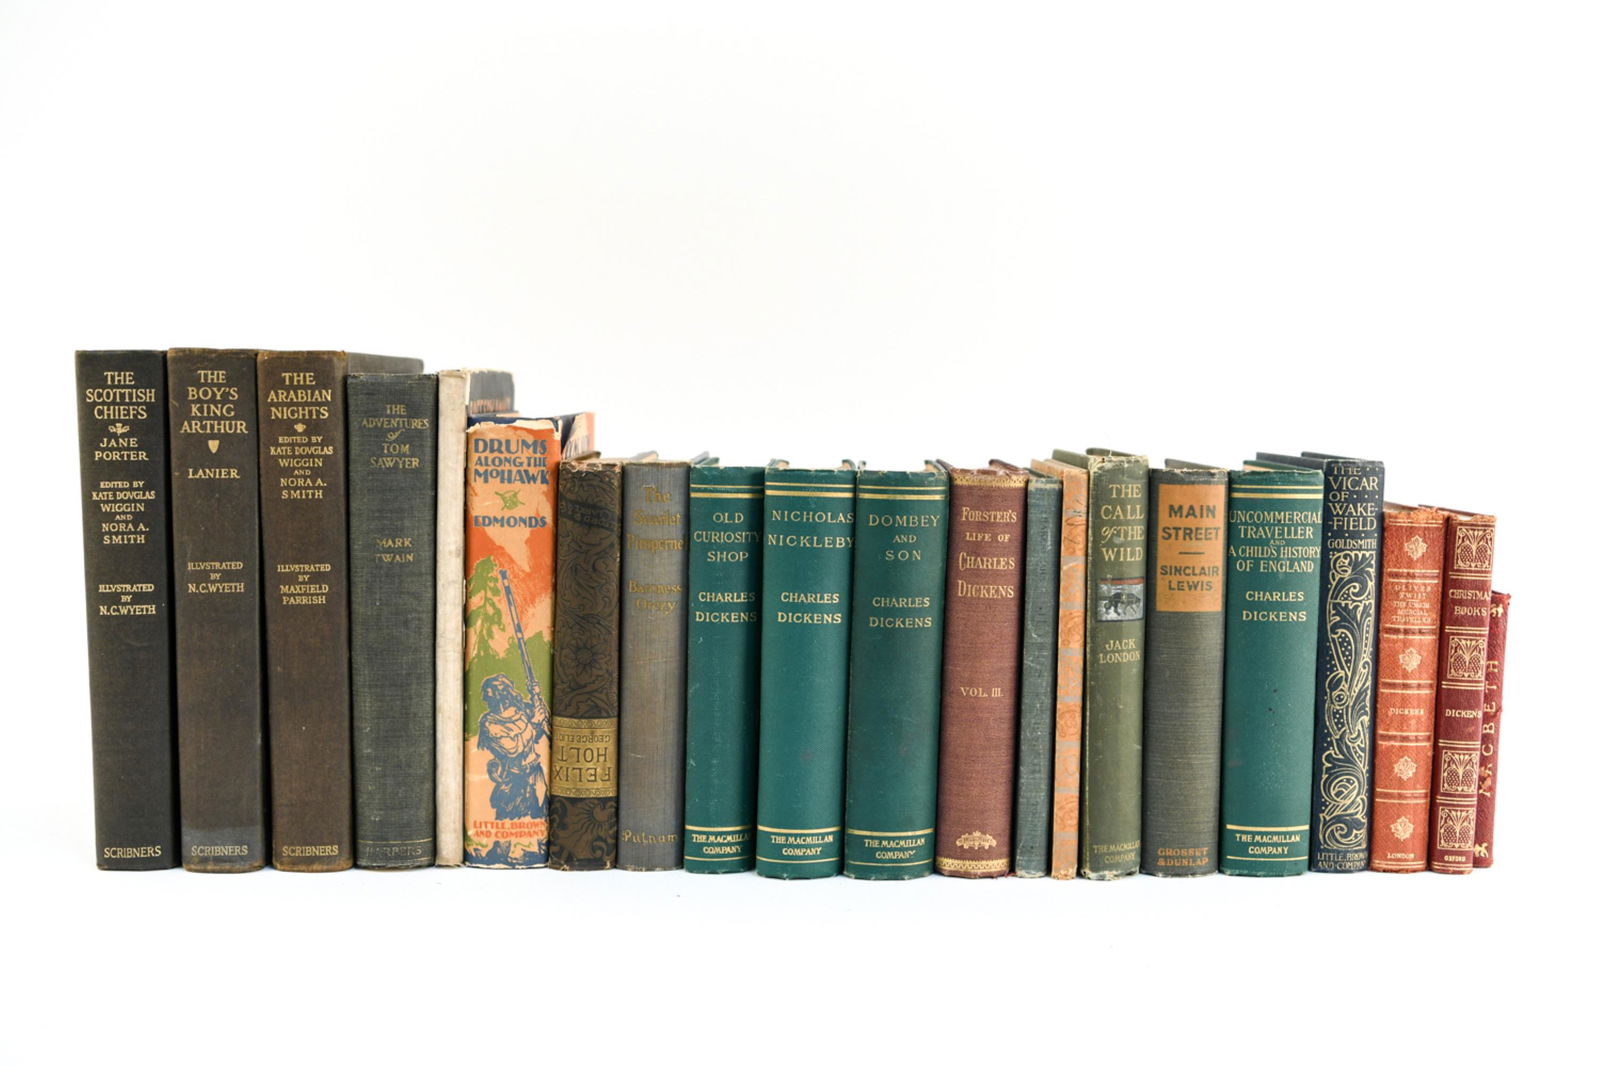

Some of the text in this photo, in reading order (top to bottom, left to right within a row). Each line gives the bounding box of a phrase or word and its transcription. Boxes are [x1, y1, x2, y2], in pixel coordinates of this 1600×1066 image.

[104, 371, 134, 385] THE
[198, 370, 227, 383] THE
[281, 372, 316, 385] THE
[86, 388, 156, 403] SCOTTISH
[187, 386, 239, 401] BOY'S
[267, 389, 332, 403] ARABIAN
[94, 404, 147, 420] CHIEFS
[191, 404, 235, 417] KING
[270, 406, 329, 420] NIGHTS
[386, 404, 407, 415] THE
[180, 420, 248, 434] ARTHUR
[361, 418, 430, 430] ADVENTURES
[278, 436, 323, 444] EDITED BY
[385, 429, 406, 442] of
[100, 437, 138, 448] JANE
[473, 438, 548, 455] DRUMS
[270, 446, 334, 455] KATE DOVGLAS
[382, 443, 410, 454] TOM
[95, 450, 149, 461] PORTER
[278, 458, 323, 467] WIGGIN
[369, 457, 420, 469] SAWYER
[474, 456, 548, 468] ALONG THE
[187, 468, 240, 479] LANIER
[1333, 464, 1362, 475] THE
[100, 481, 129, 489] EDITED
[280, 478, 327, 487] NORA A.
[1328, 476, 1379, 491] VICAR
[92, 490, 155, 501] KATE DOVGLAS
[281, 490, 324, 499] SMITH
[642, 485, 672, 504] The
[1109, 484, 1142, 499] THE
[1329, 492, 1349, 502] OF
[100, 503, 145, 513] WIGGIN
[1100, 504, 1145, 520] CALL
[1168, 504, 1217, 519] MAIN
[473, 515, 547, 529] EDMONDS
[712, 512, 744, 524] OLD
[771, 510, 855, 523] NICHOLAS
[868, 514, 941, 528] DOMBEY
[1229, 510, 1322, 524] UNCOMMERCIAL
[101, 522, 149, 532] NORA A.
[1237, 525, 1314, 539] TRAVELLER
[693, 531, 762, 543] CURIOSITY
[893, 535, 917, 543] AND
[965, 532, 1011, 543] LIFE OF
[1101, 525, 1144, 543] of THE
[1161, 527, 1221, 541] STREET
[103, 535, 145, 545] SMITH
[376, 537, 412, 548] MARK
[767, 534, 855, 548] NICKLEBY
[1327, 538, 1377, 549] GOLDSMITH
[375, 552, 414, 563] TWAIN
[707, 551, 749, 562] SHOP
[885, 550, 922, 561] SON
[1102, 547, 1143, 562] WILD
[1229, 546, 1321, 558] A CHILD'S HISTORY
[187, 561, 243, 570] ILLVSTRATED
[958, 552, 1016, 571] CHARLES
[1236, 560, 1314, 573] OF ENGLAND
[277, 564, 331, 572] ILLVSTRATED
[1159, 565, 1220, 577] SINCLAIR
[210, 572, 222, 580] BY
[298, 574, 310, 582] BY
[98, 584, 155, 593] ILLVSTRATED
[280, 584, 329, 594] MAXFIELD
[957, 579, 1015, 599] DICKENS
[1168, 580, 1213, 591] LEWIS
[121, 594, 132, 603] BY
[282, 595, 326, 606] PARRISH
[698, 592, 756, 602] CHARLES
[780, 592, 840, 604] CHARLES
[1245, 590, 1305, 602] CHARLES
[1449, 589, 1491, 601] CHRISTMA
[872, 597, 931, 608] CHARLES
[1242, 611, 1307, 622] DICKENS
[1454, 605, 1487, 617] BOOKS
[695, 611, 757, 623] DICKENS
[777, 612, 842, 624] DICKENS
[869, 617, 932, 628] DICKENS
[1106, 638, 1136, 650] JACK
[1099, 649, 1141, 664] LONDON
[960, 687, 988, 697] VOL.
[576, 734, 611, 743] GEORGE
[557, 746, 609, 763] HOLT
[554, 766, 613, 783] FELIX
[510, 820, 545, 831] BROWN
[474, 831, 545, 840] AND COMPANY
[621, 830, 678, 844] Putnam
[692, 834, 708, 843] THE
[770, 835, 834, 845] THE MACMILLAN
[1235, 834, 1301, 843] THE MACMILLAN
[863, 838, 926, 848] THE MACMILLAN
[1092, 844, 1109, 853] THE
[104, 845, 162, 859] SCRIBNERS
[191, 844, 248, 858] SCRIBNERS
[282, 844, 339, 858] SCRIBNERS
[703, 845, 742, 855] COMPANY
[782, 847, 822, 856] COMPANY
[875, 850, 916, 860] COMPANY
[1157, 847, 1209, 856] GROSSET
[1248, 846, 1289, 855] COMPANY
[1104, 852, 1136, 864] COMPANY
[1318, 861, 1334, 870] AND
